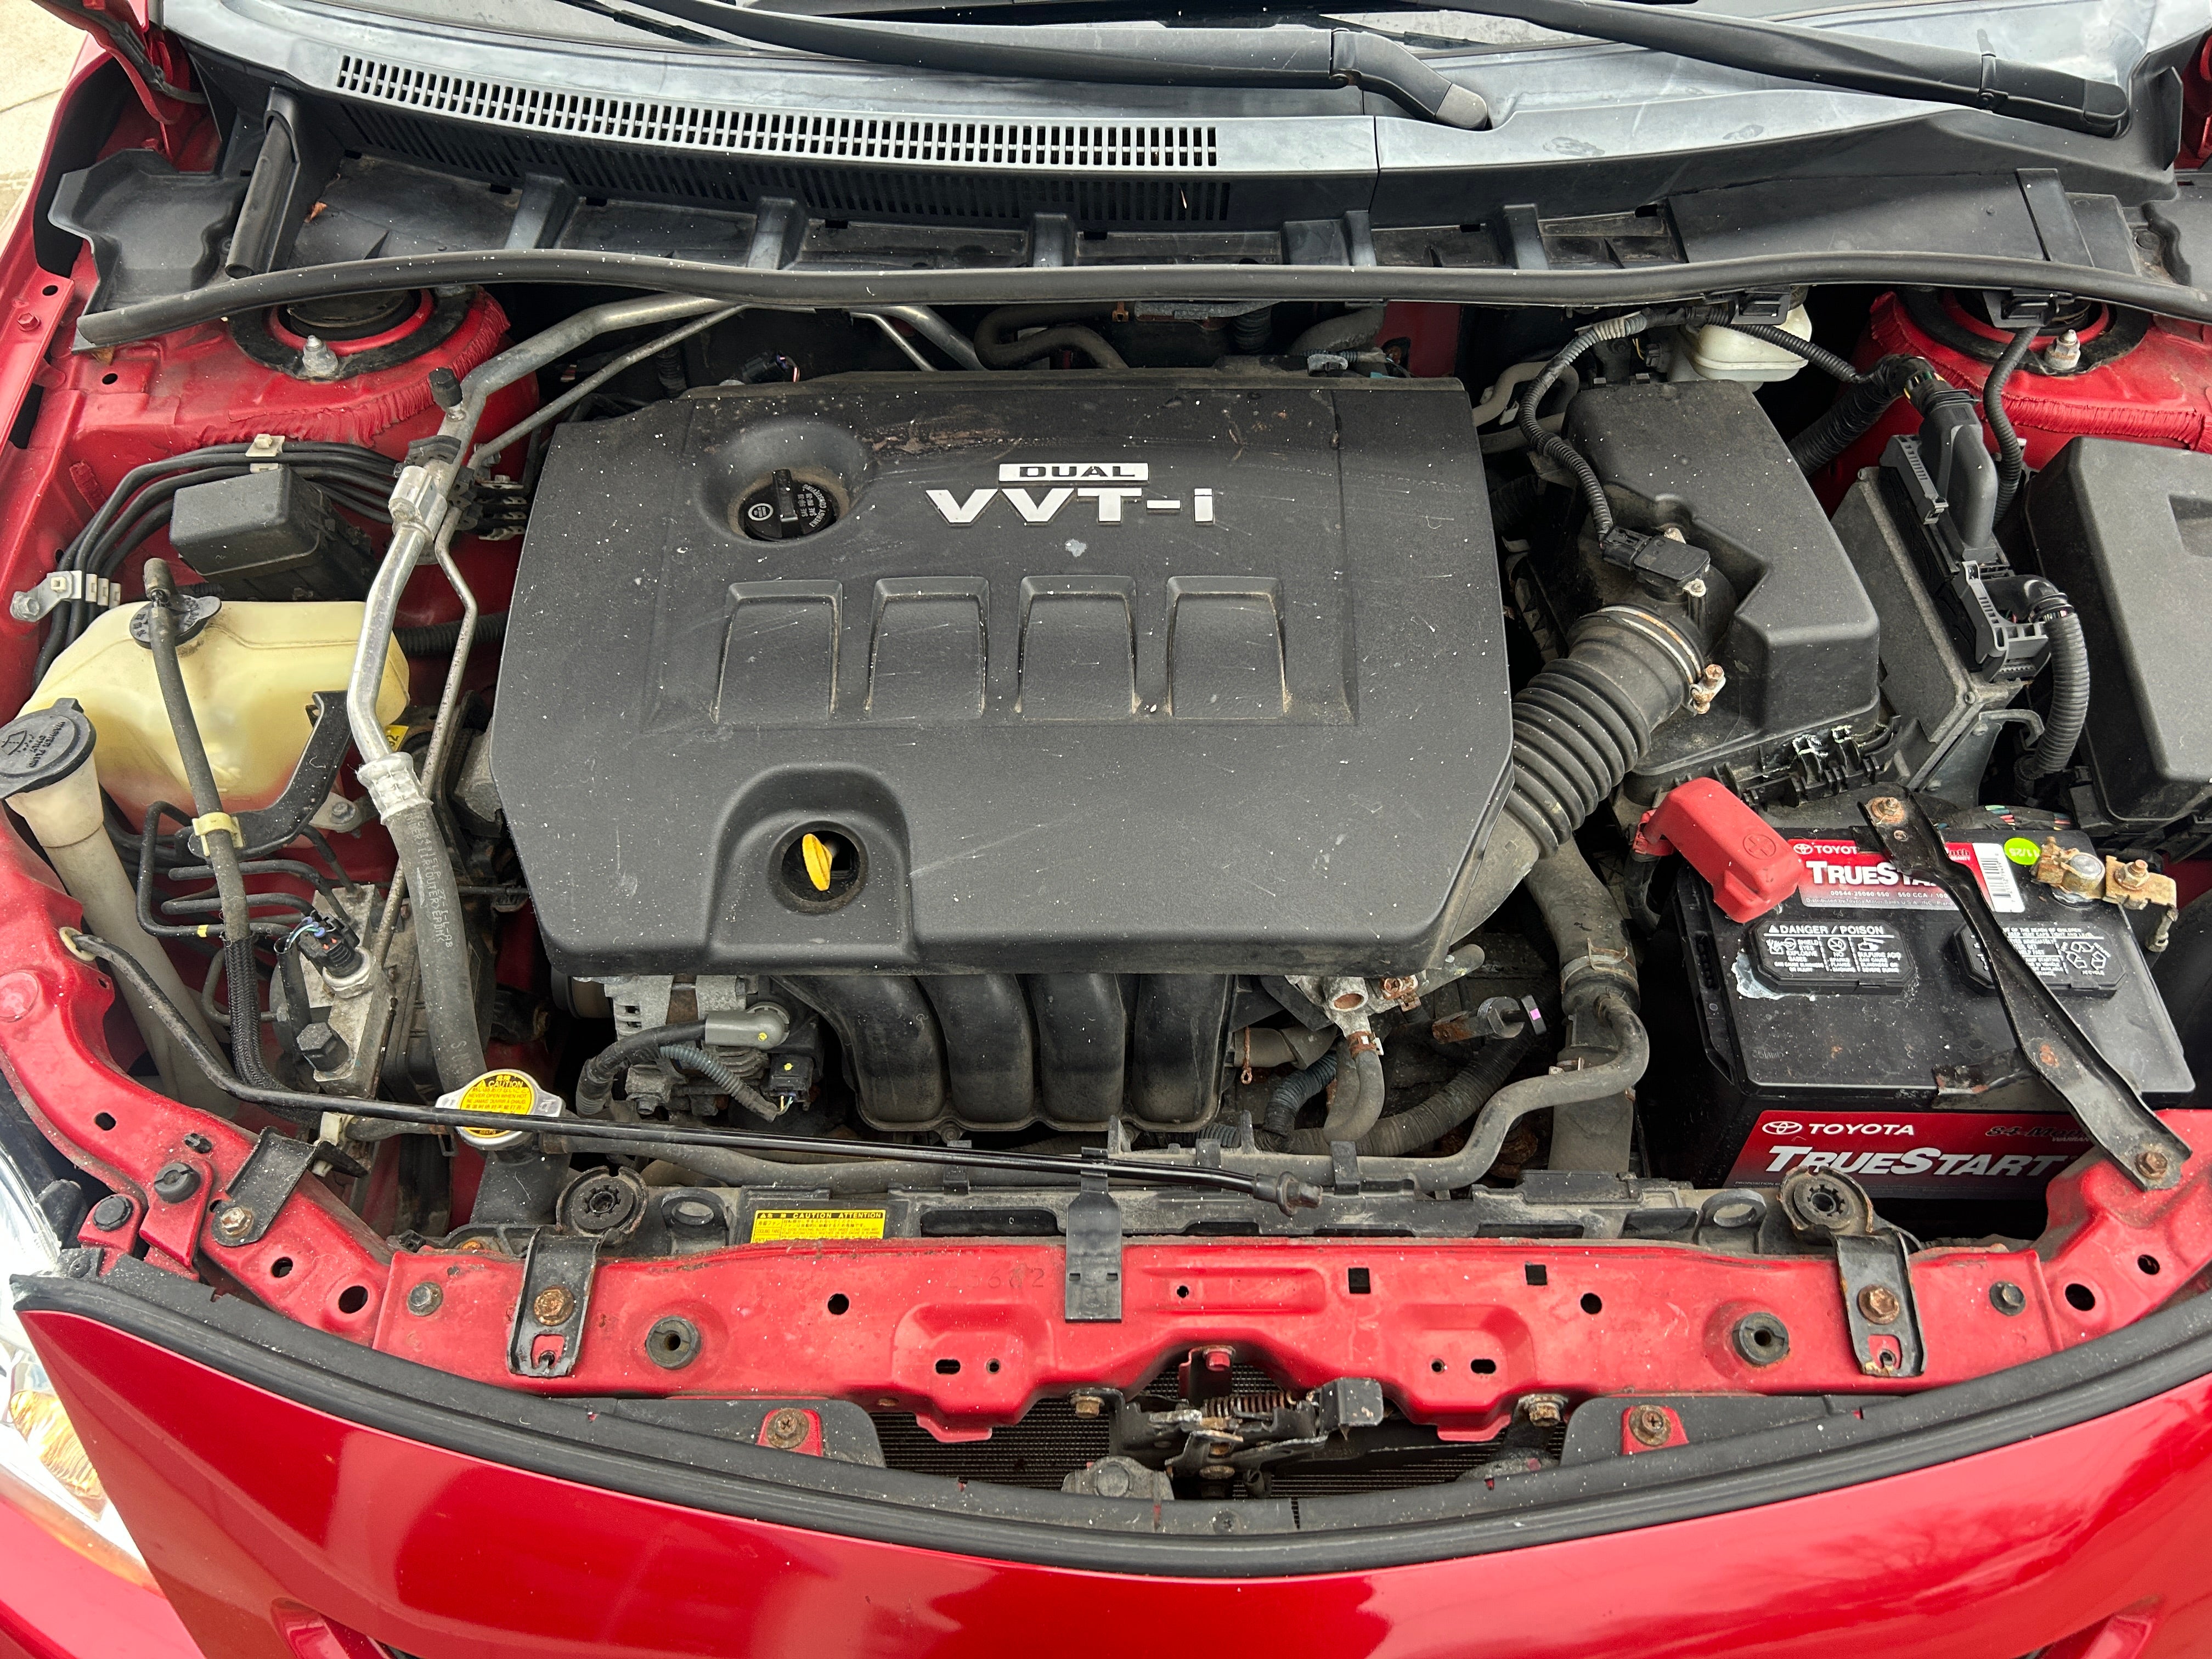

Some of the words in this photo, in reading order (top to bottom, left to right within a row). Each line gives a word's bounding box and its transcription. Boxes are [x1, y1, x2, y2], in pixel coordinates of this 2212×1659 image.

[1018, 466, 1136, 478] DUAL
[802, 484, 827, 509] CONSERVING
[925, 487, 1215, 526] VVT-i
[809, 509, 827, 528] ENERGY
[1813, 845, 1858, 854] TOYOT
[1779, 925, 1828, 934] DANGER
[1831, 926, 1838, 934] /
[1839, 926, 1884, 935] POISON
[1808, 1123, 1915, 1136] TOYOTA
